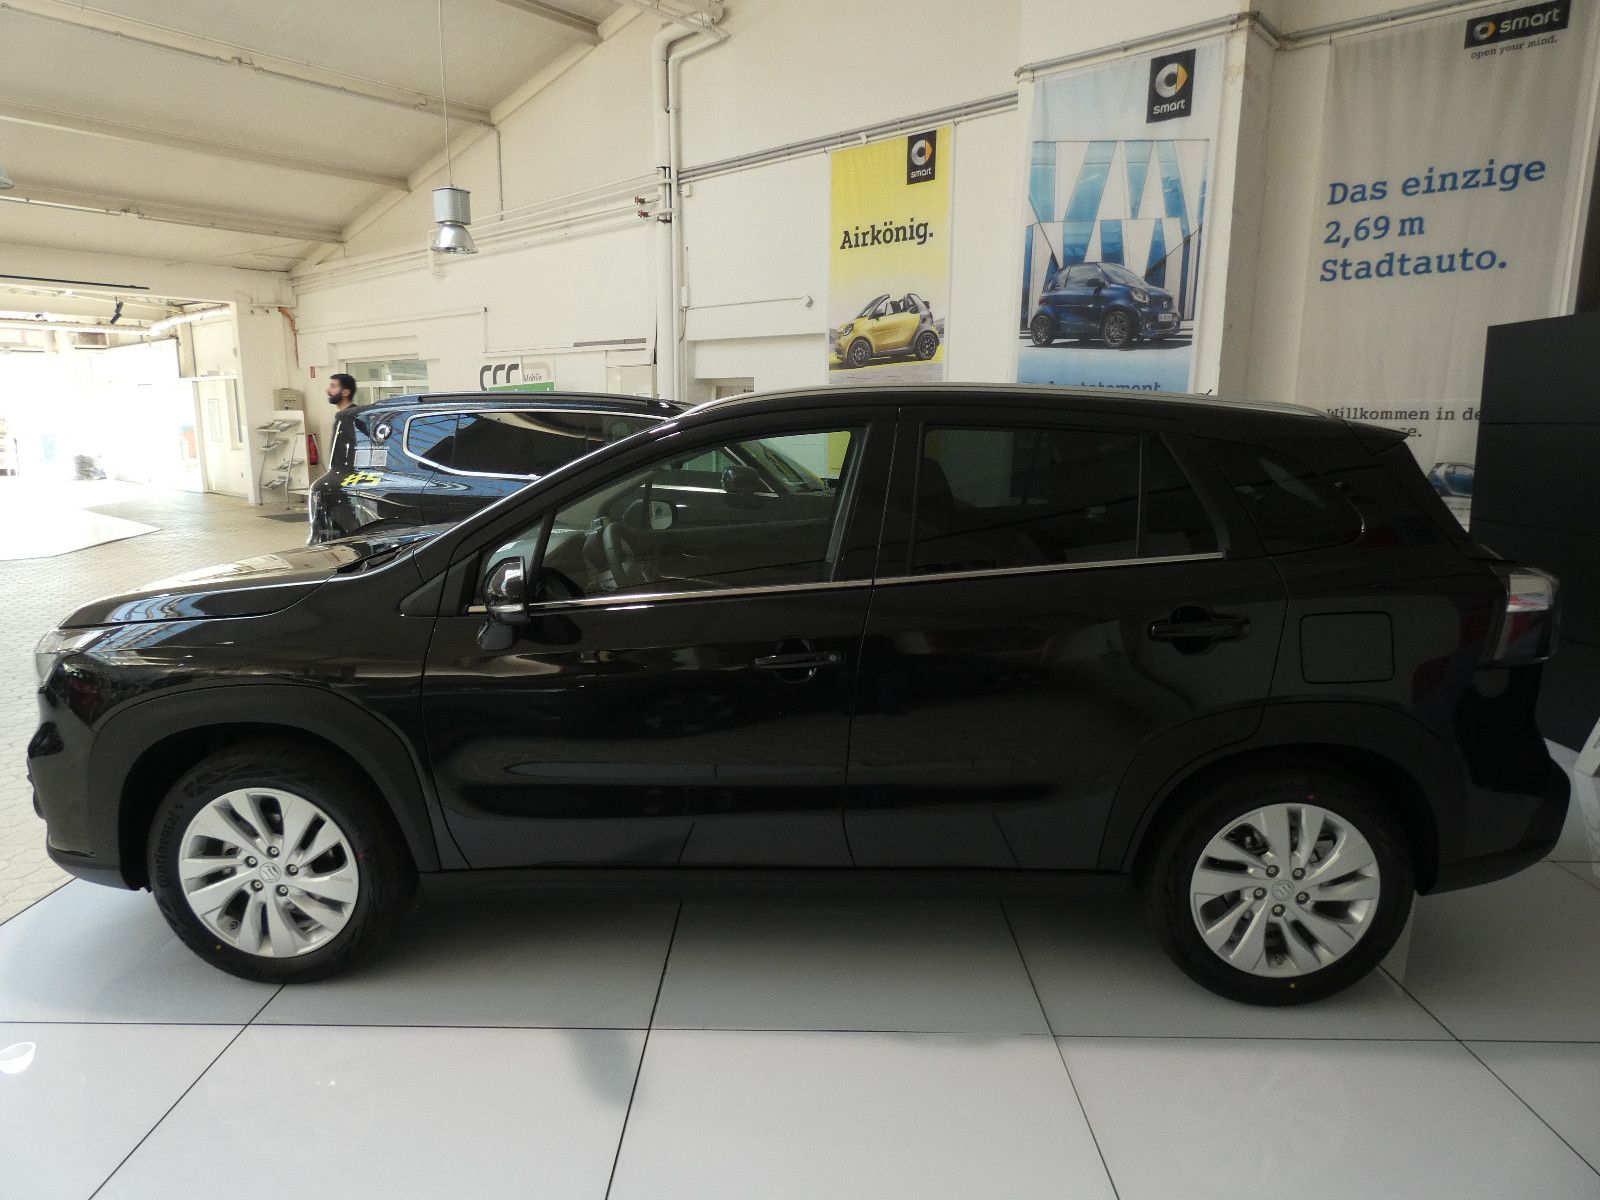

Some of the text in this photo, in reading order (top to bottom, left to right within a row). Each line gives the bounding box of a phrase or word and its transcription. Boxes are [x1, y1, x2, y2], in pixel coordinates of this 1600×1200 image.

[1499, 7, 1561, 34] smart
[1470, 35, 1557, 59] open your mind.
[1152, 99, 1186, 115] smart
[910, 167, 932, 179] smart
[1326, 158, 1547, 206] Das einzige
[839, 217, 934, 250] Airkönig.
[1323, 214, 1425, 248] 2,69 m
[1319, 247, 1508, 283] Stadtauto.
[1326, 407, 1430, 421] Willkommen
[1435, 407, 1455, 420] in
